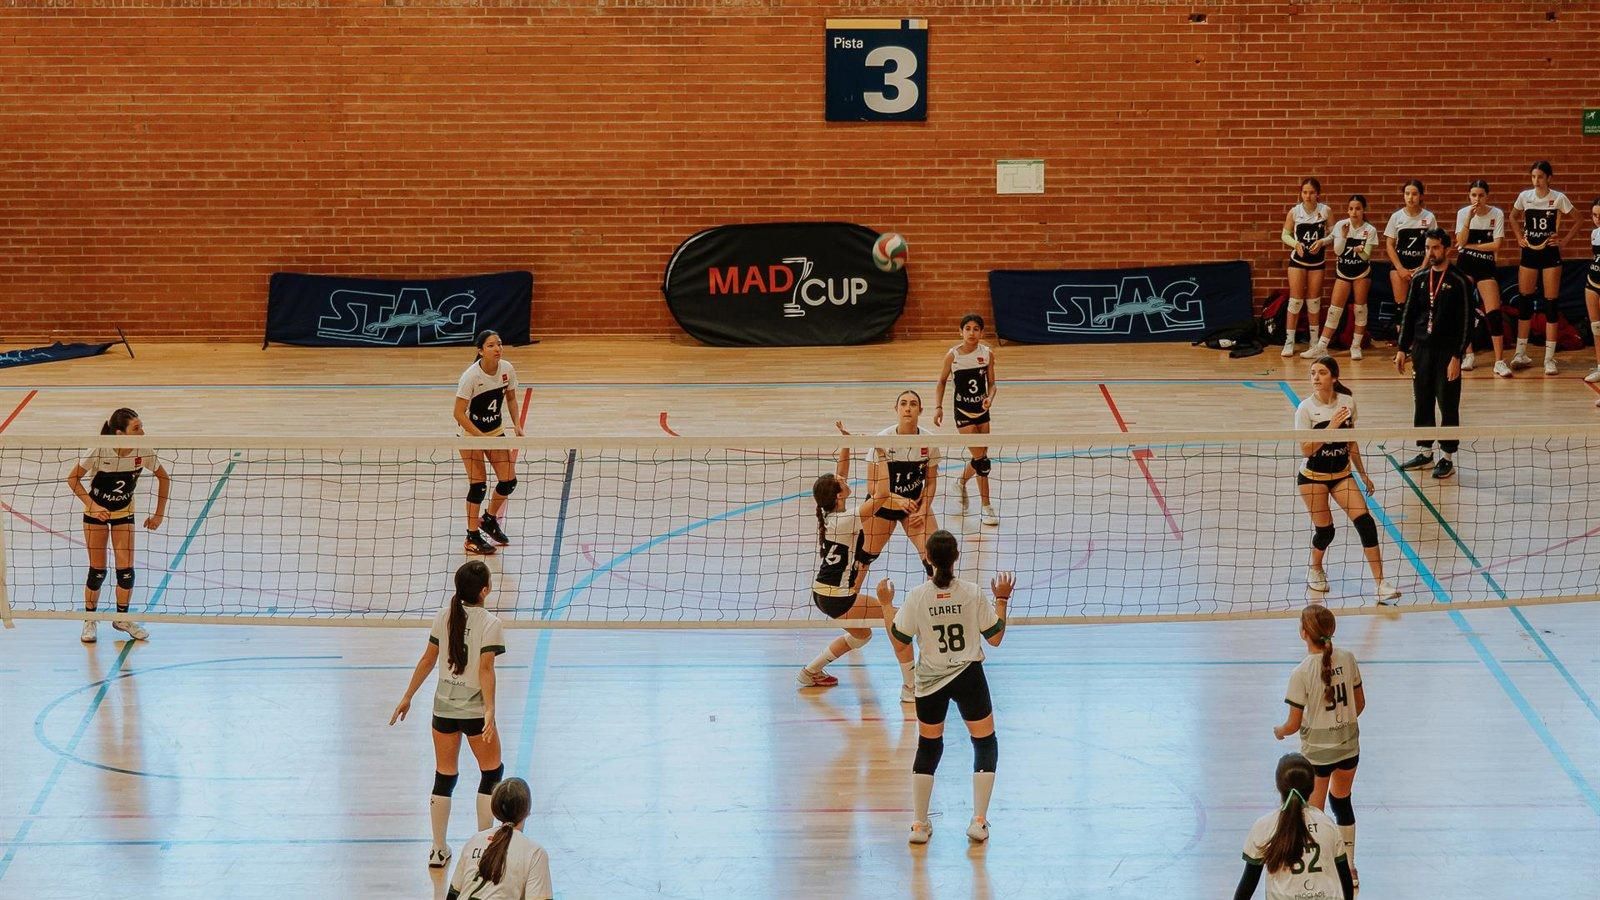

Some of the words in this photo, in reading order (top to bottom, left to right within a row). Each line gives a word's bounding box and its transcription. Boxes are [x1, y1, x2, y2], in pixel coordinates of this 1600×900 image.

[833, 37, 864, 49] Pista
[863, 45, 919, 114] 3
[1532, 217, 1547, 230] 18
[1303, 230, 1318, 243] 44
[1407, 236, 1418, 249] 7
[708, 265, 795, 296] MAD
[801, 277, 868, 307] CUP
[1046, 276, 1206, 335] STAG
[316, 288, 477, 346] STAG
[968, 379, 979, 394] 3
[487, 399, 498, 413] 4
[112, 480, 126, 494] 2
[928, 604, 962, 617] CLARET
[932, 623, 966, 654] 38
